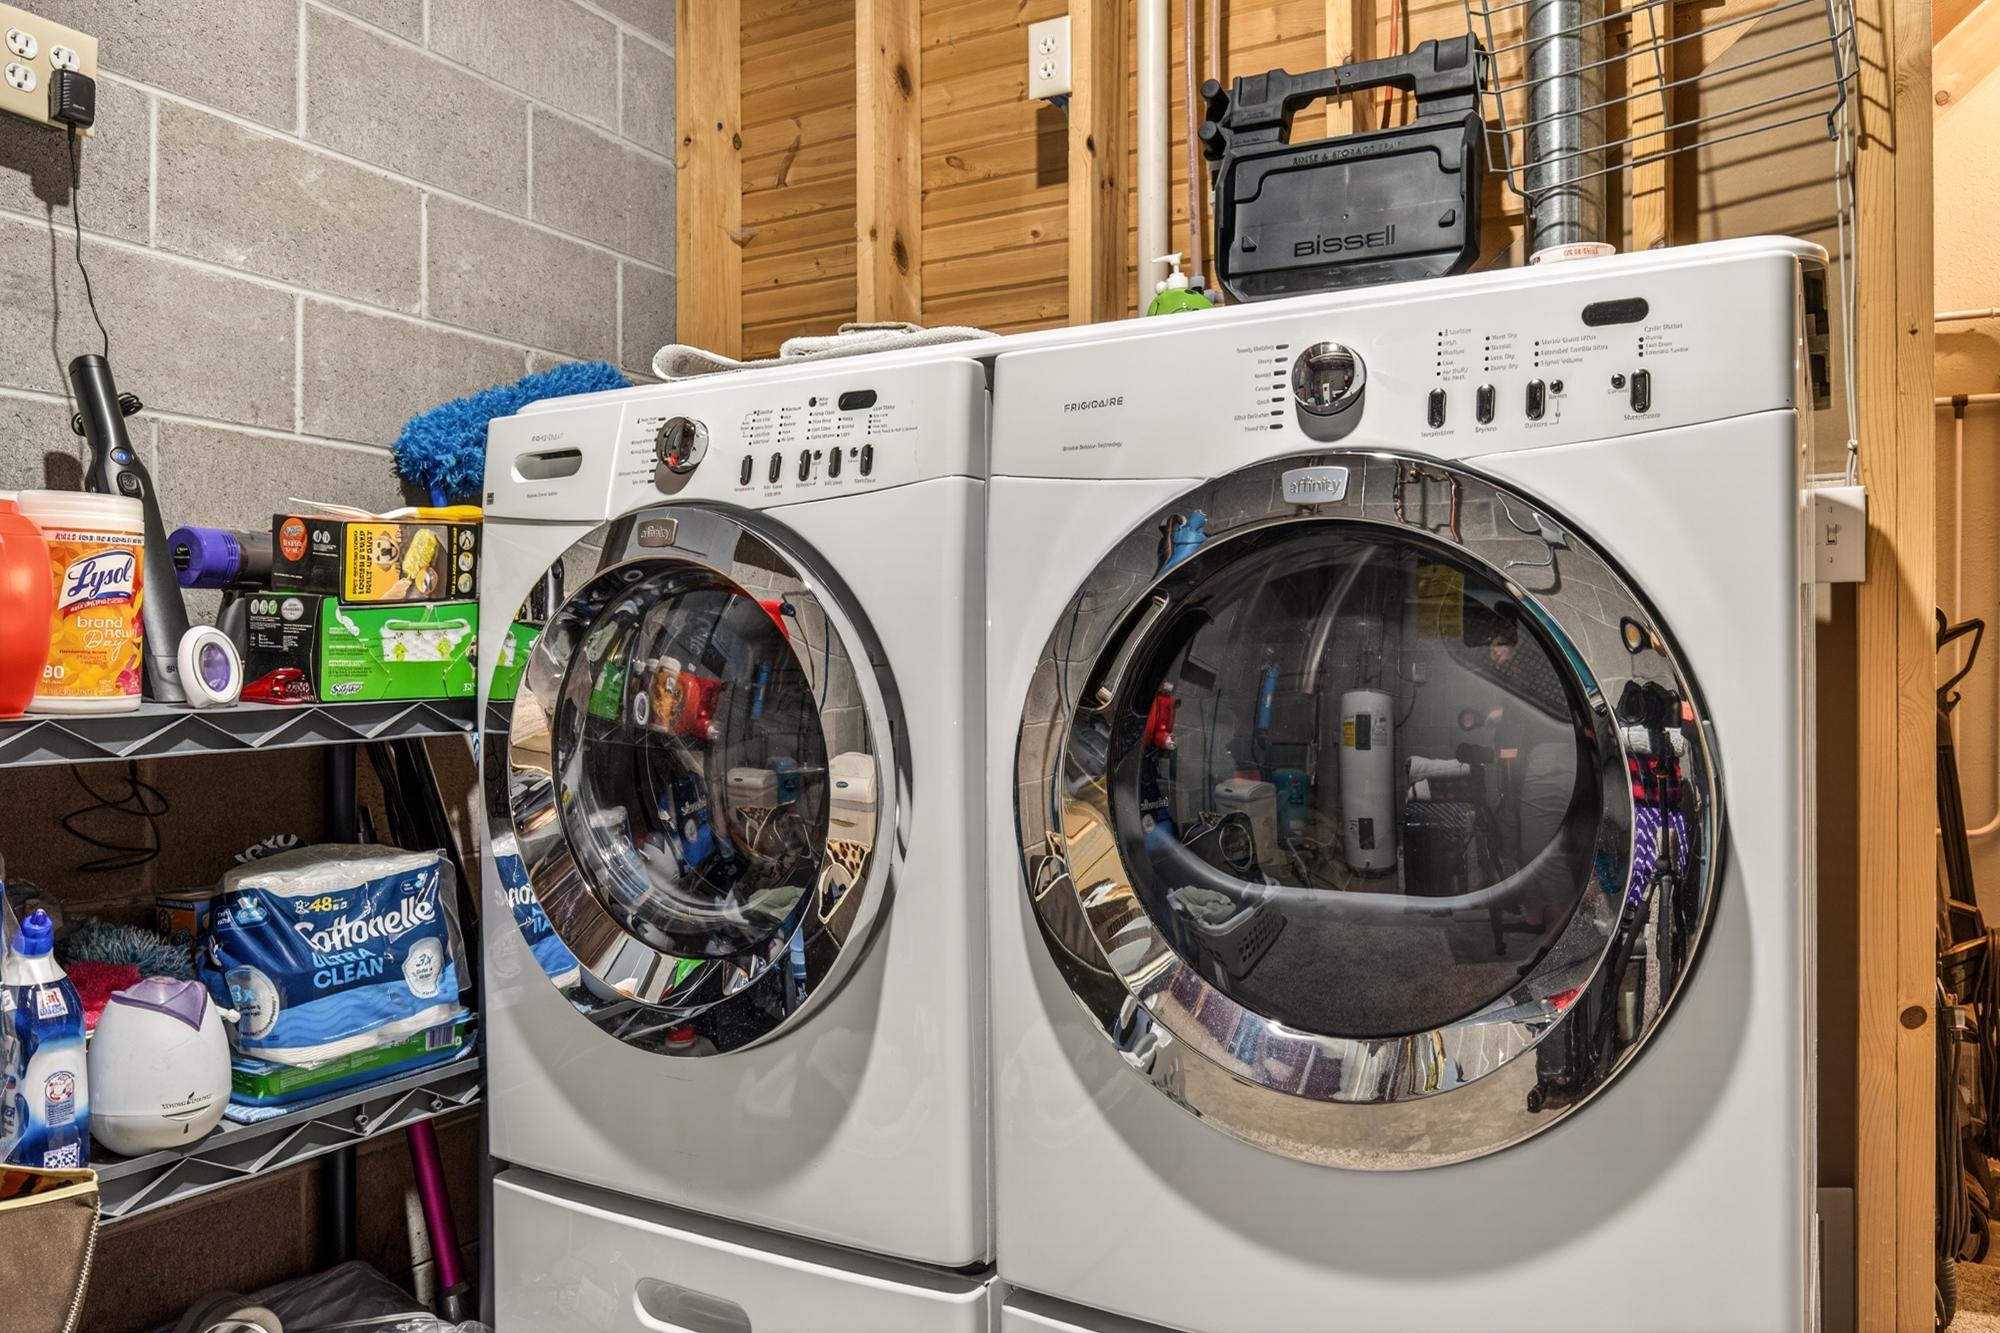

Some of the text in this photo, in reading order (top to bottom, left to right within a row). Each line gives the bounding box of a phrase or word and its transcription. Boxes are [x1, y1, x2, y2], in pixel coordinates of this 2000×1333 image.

[1064, 396, 1124, 413] FRIGIDAIRE
[1289, 475, 1343, 496] affinity
[67, 557, 133, 598] Lysol
[77, 616, 123, 629] brand
[104, 628, 132, 639] new
[83, 629, 130, 662] Day
[43, 664, 65, 679] 80
[294, 895, 436, 953] Cottonelle
[313, 956, 384, 989] CLEAN
